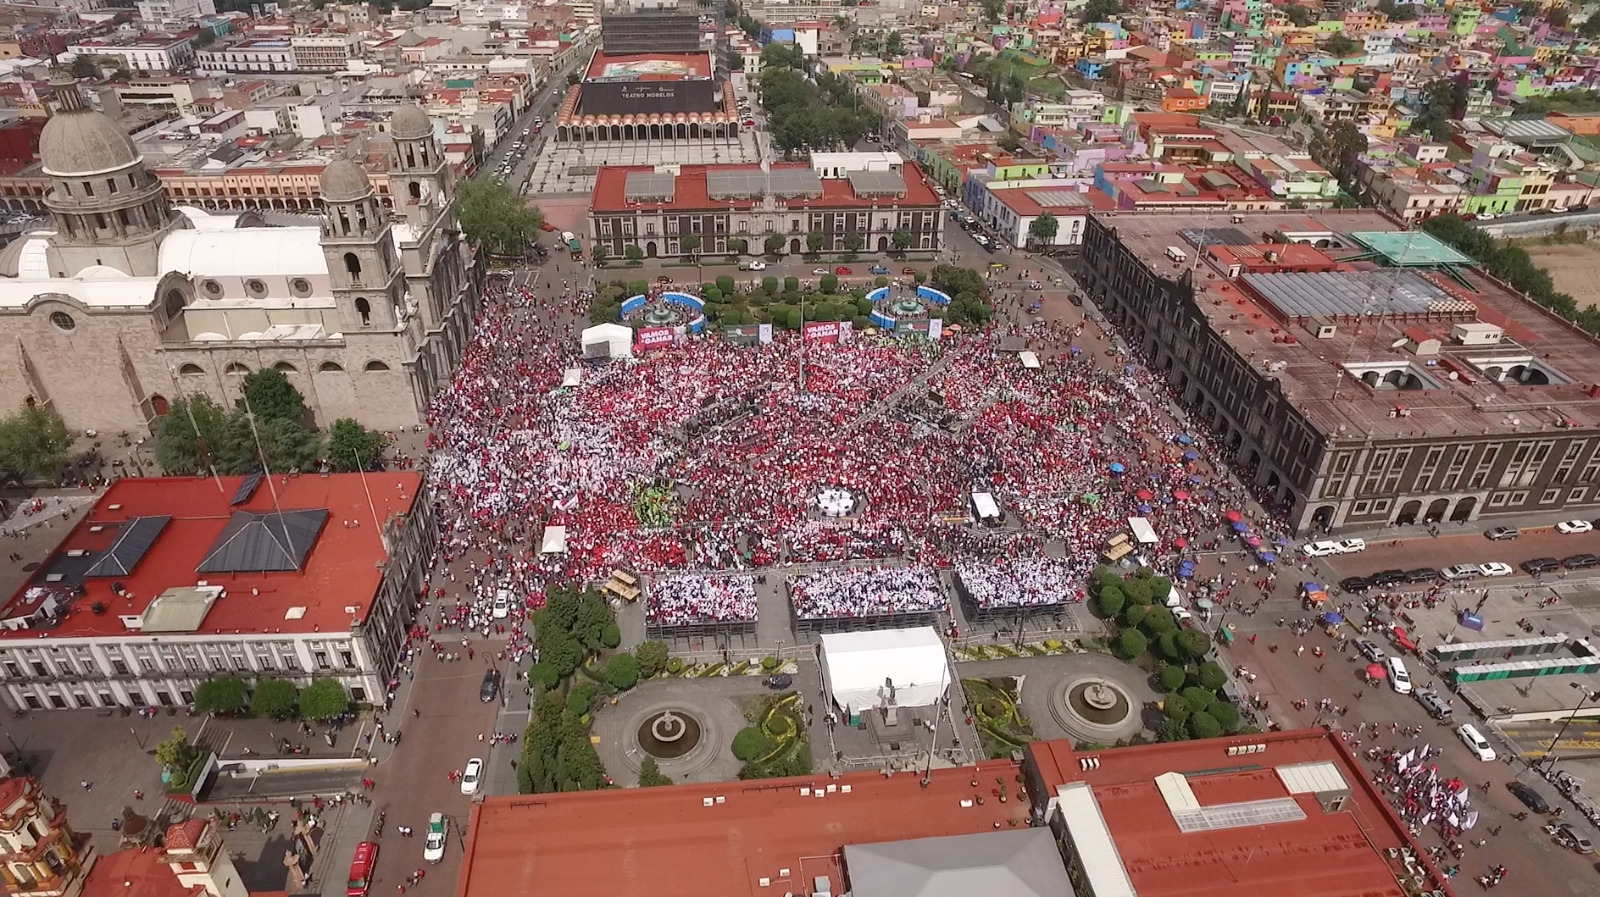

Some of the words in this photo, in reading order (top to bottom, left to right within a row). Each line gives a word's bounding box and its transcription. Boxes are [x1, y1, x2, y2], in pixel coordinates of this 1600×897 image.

[807, 324, 835, 333] VAMOS
[640, 330, 669, 338] VAMOS
[811, 329, 838, 338] GANAR
[645, 335, 673, 344] GANAR
